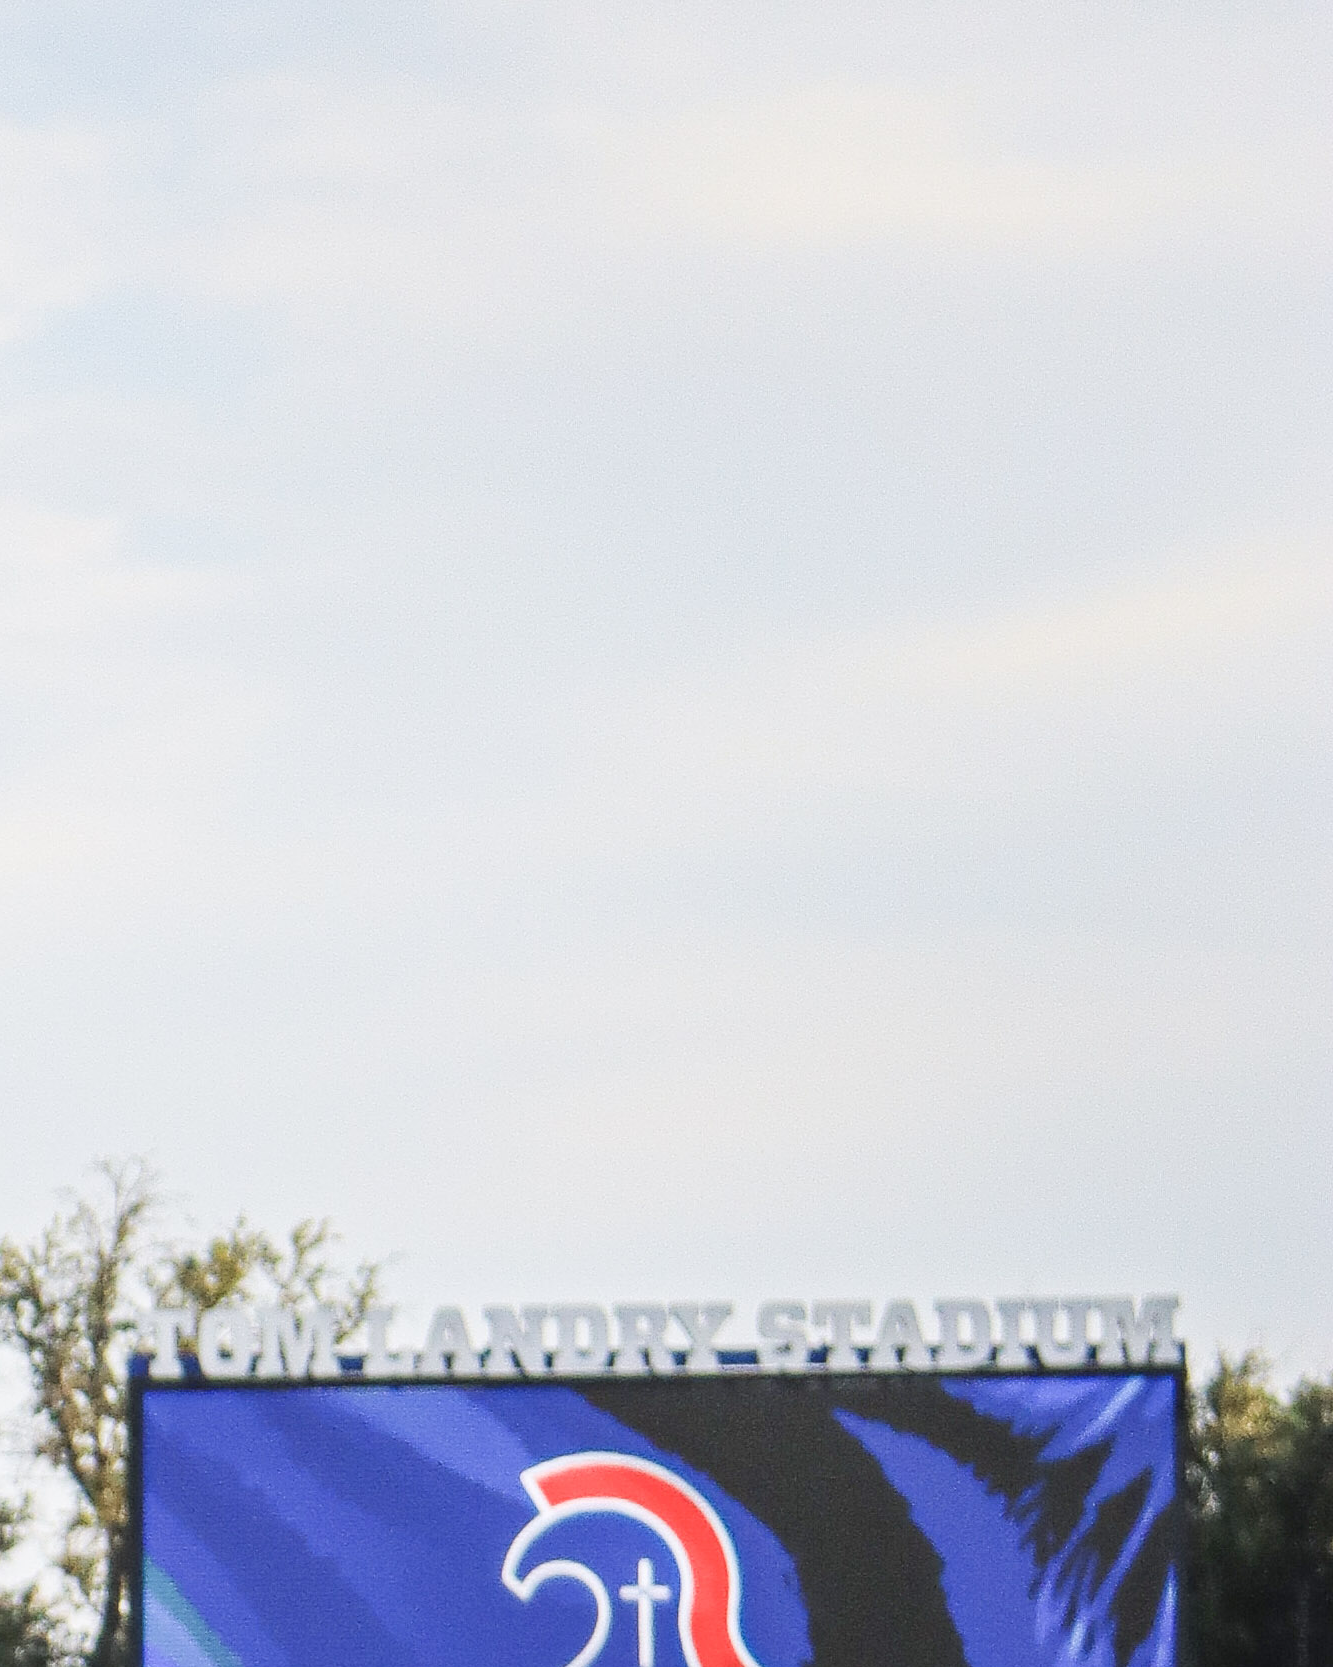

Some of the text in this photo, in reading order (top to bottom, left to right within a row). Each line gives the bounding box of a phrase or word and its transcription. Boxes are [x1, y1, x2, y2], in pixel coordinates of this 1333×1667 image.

[139, 1296, 1181, 1377] TOM LANDRY STADIUM
